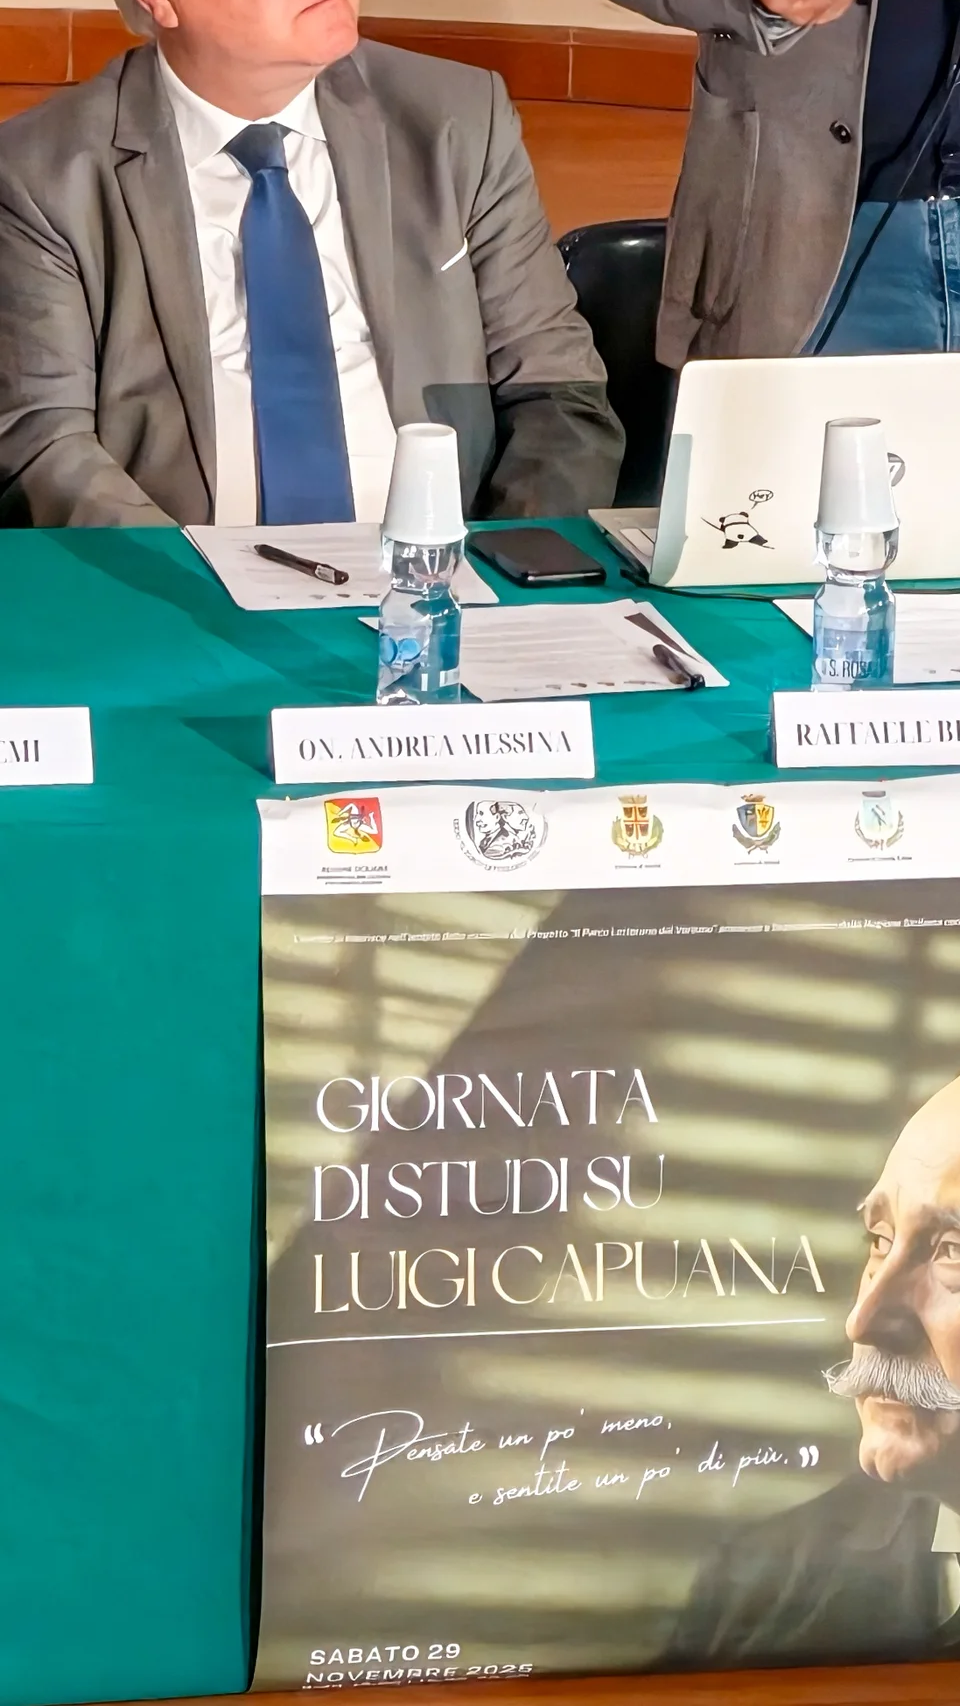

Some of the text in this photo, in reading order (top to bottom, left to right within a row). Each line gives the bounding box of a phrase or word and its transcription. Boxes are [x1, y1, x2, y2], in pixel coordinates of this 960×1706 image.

[299, 730, 572, 761] ON. ANDREA MESSINA
[796, 720, 931, 746] RAFFAELE
[316, 1067, 659, 1133] GIORNATA
[314, 1154, 665, 1222] DI STUDI SU
[314, 1234, 826, 1313] LUIGI CAPUANA
[498, 1434, 534, 1450] un
[601, 1415, 672, 1435] meno,
[468, 1492, 484, 1505] e
[493, 1460, 582, 1506] sentite
[594, 1475, 630, 1489] un
[697, 1440, 726, 1474] di
[310, 1643, 461, 1666] SABATO 29
